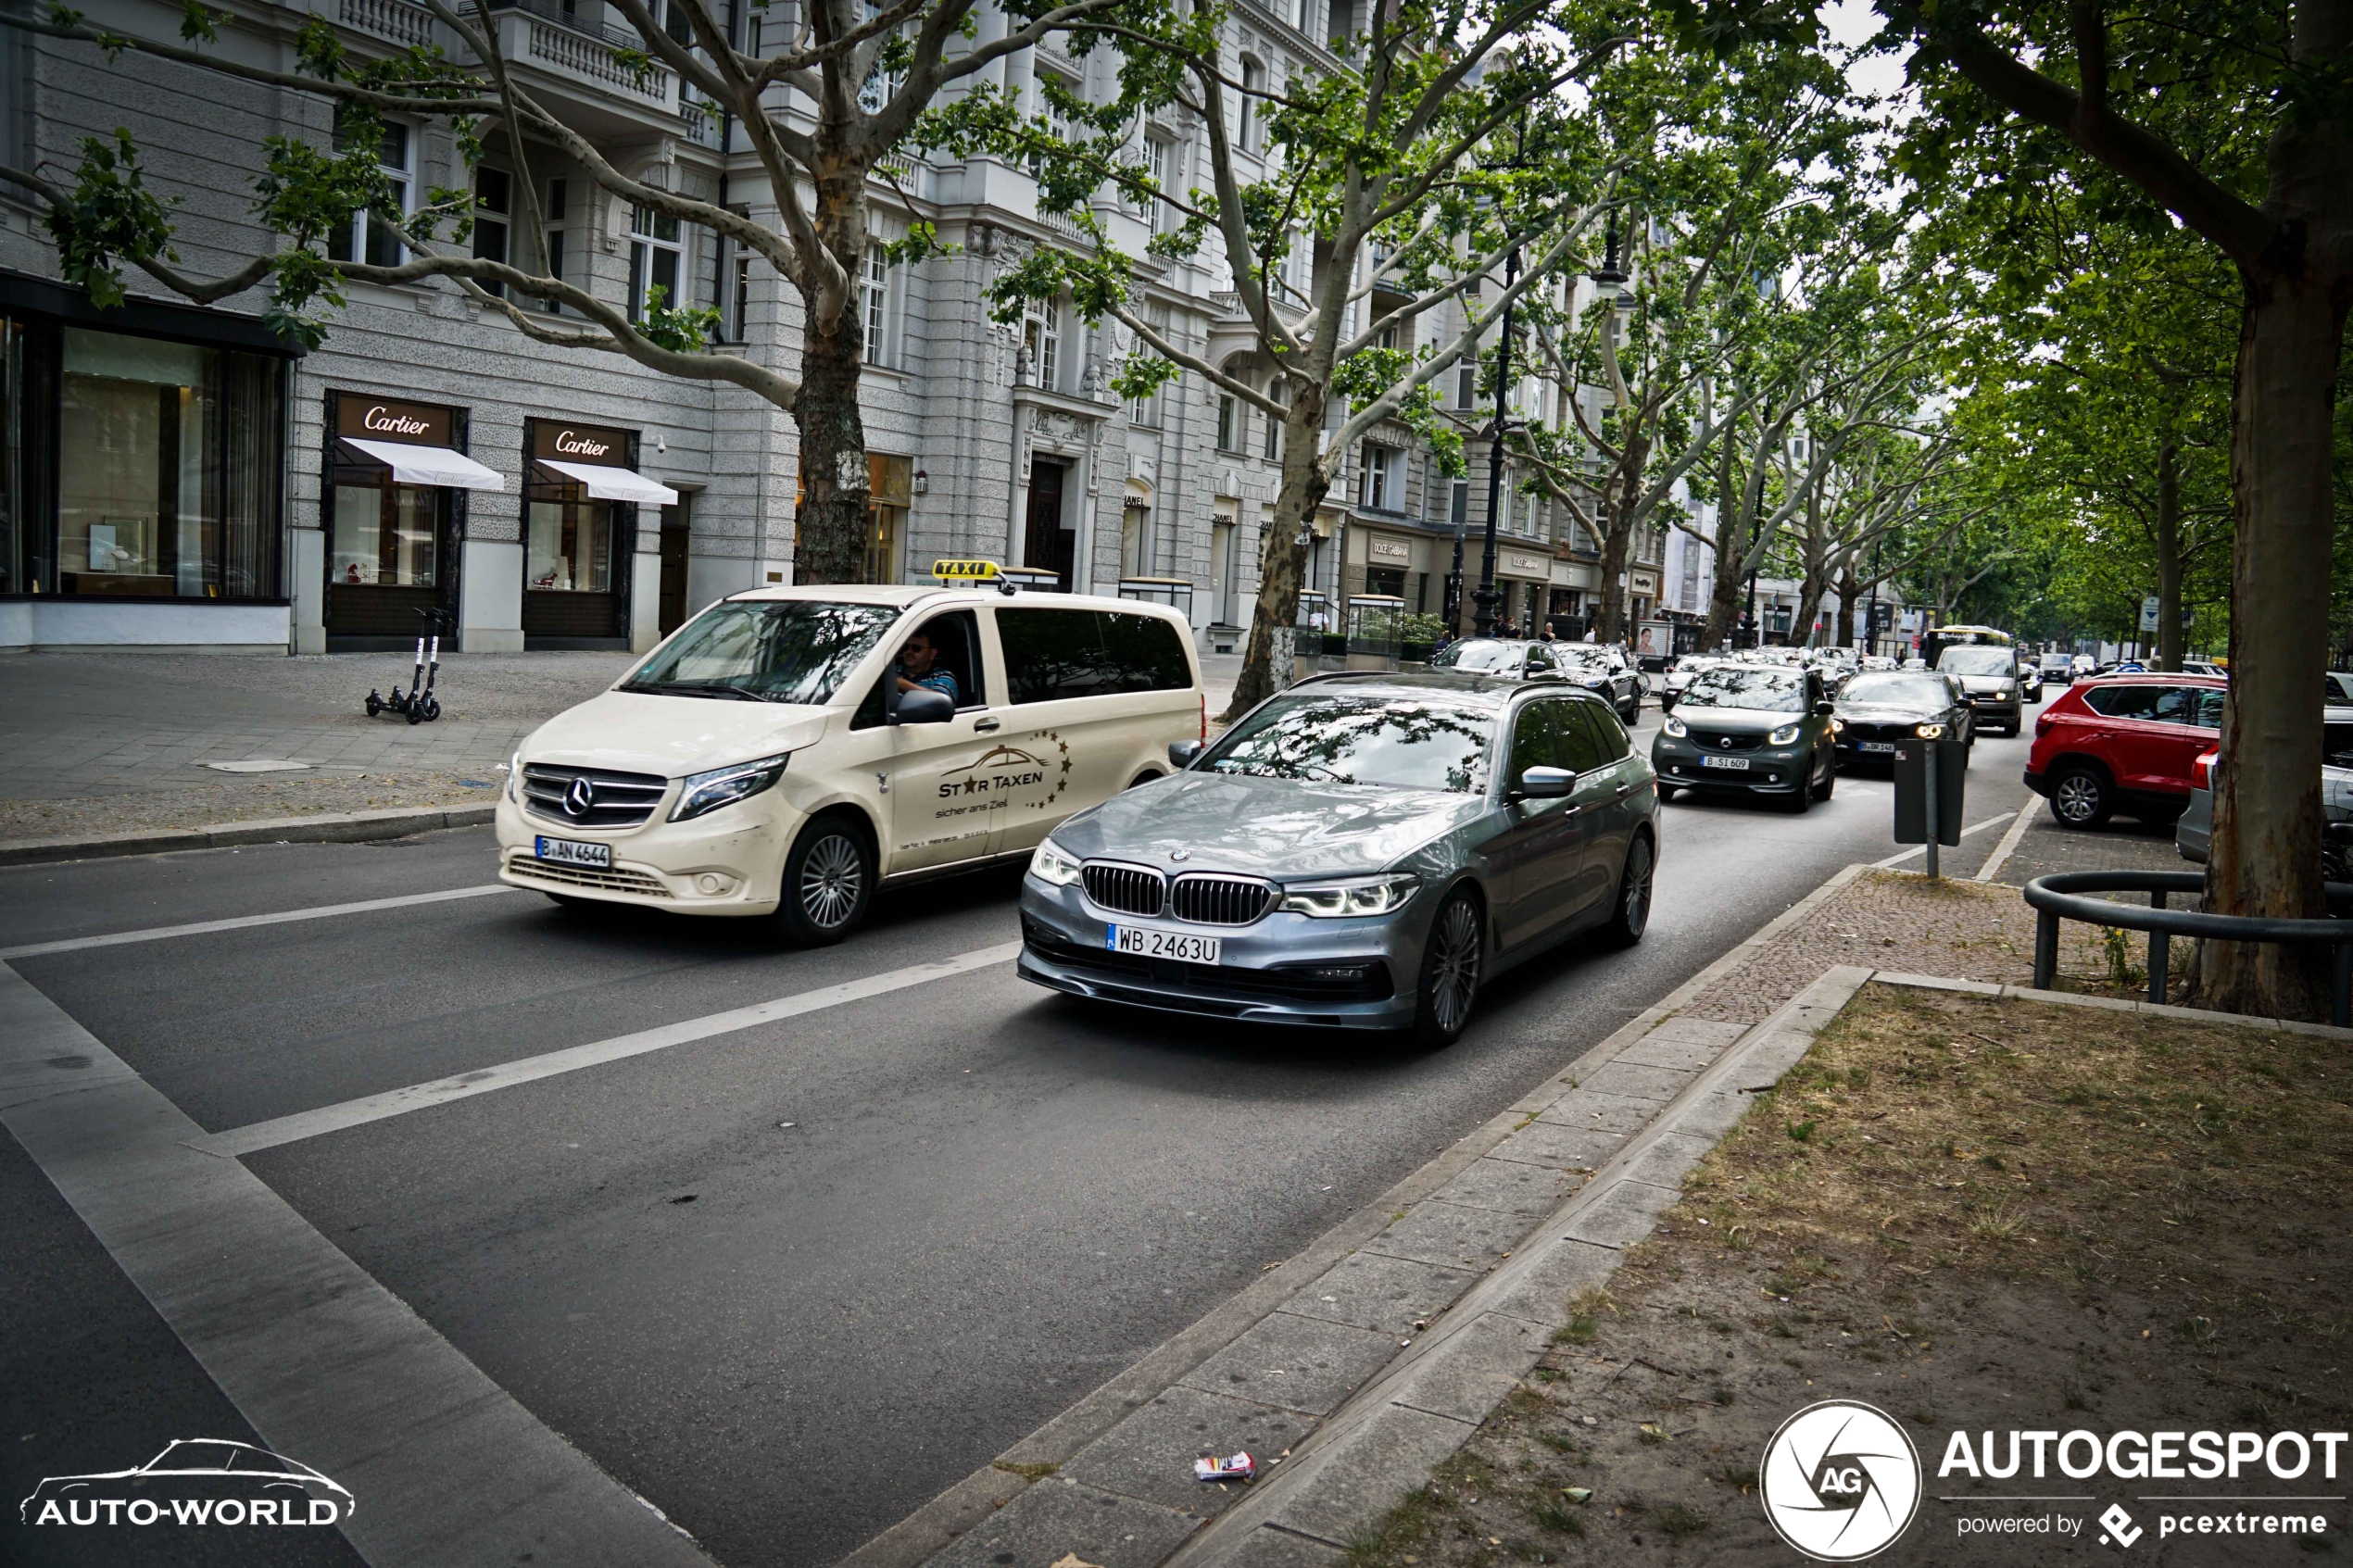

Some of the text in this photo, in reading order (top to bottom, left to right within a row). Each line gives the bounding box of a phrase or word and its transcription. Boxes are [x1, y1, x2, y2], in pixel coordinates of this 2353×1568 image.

[364, 406, 430, 434] Cartier
[556, 431, 610, 457] Cartier
[434, 472, 467, 485] Cartier
[621, 488, 648, 501] Cartier
[941, 562, 980, 574] TAXI
[1707, 757, 1713, 765] B
[1730, 759, 1746, 768] 609
[992, 771, 1043, 789] TAXEN
[935, 807, 967, 819] sicher
[968, 803, 988, 813] ans
[542, 840, 607, 863] B AN 4644
[1120, 928, 1216, 961] WB 2463U
